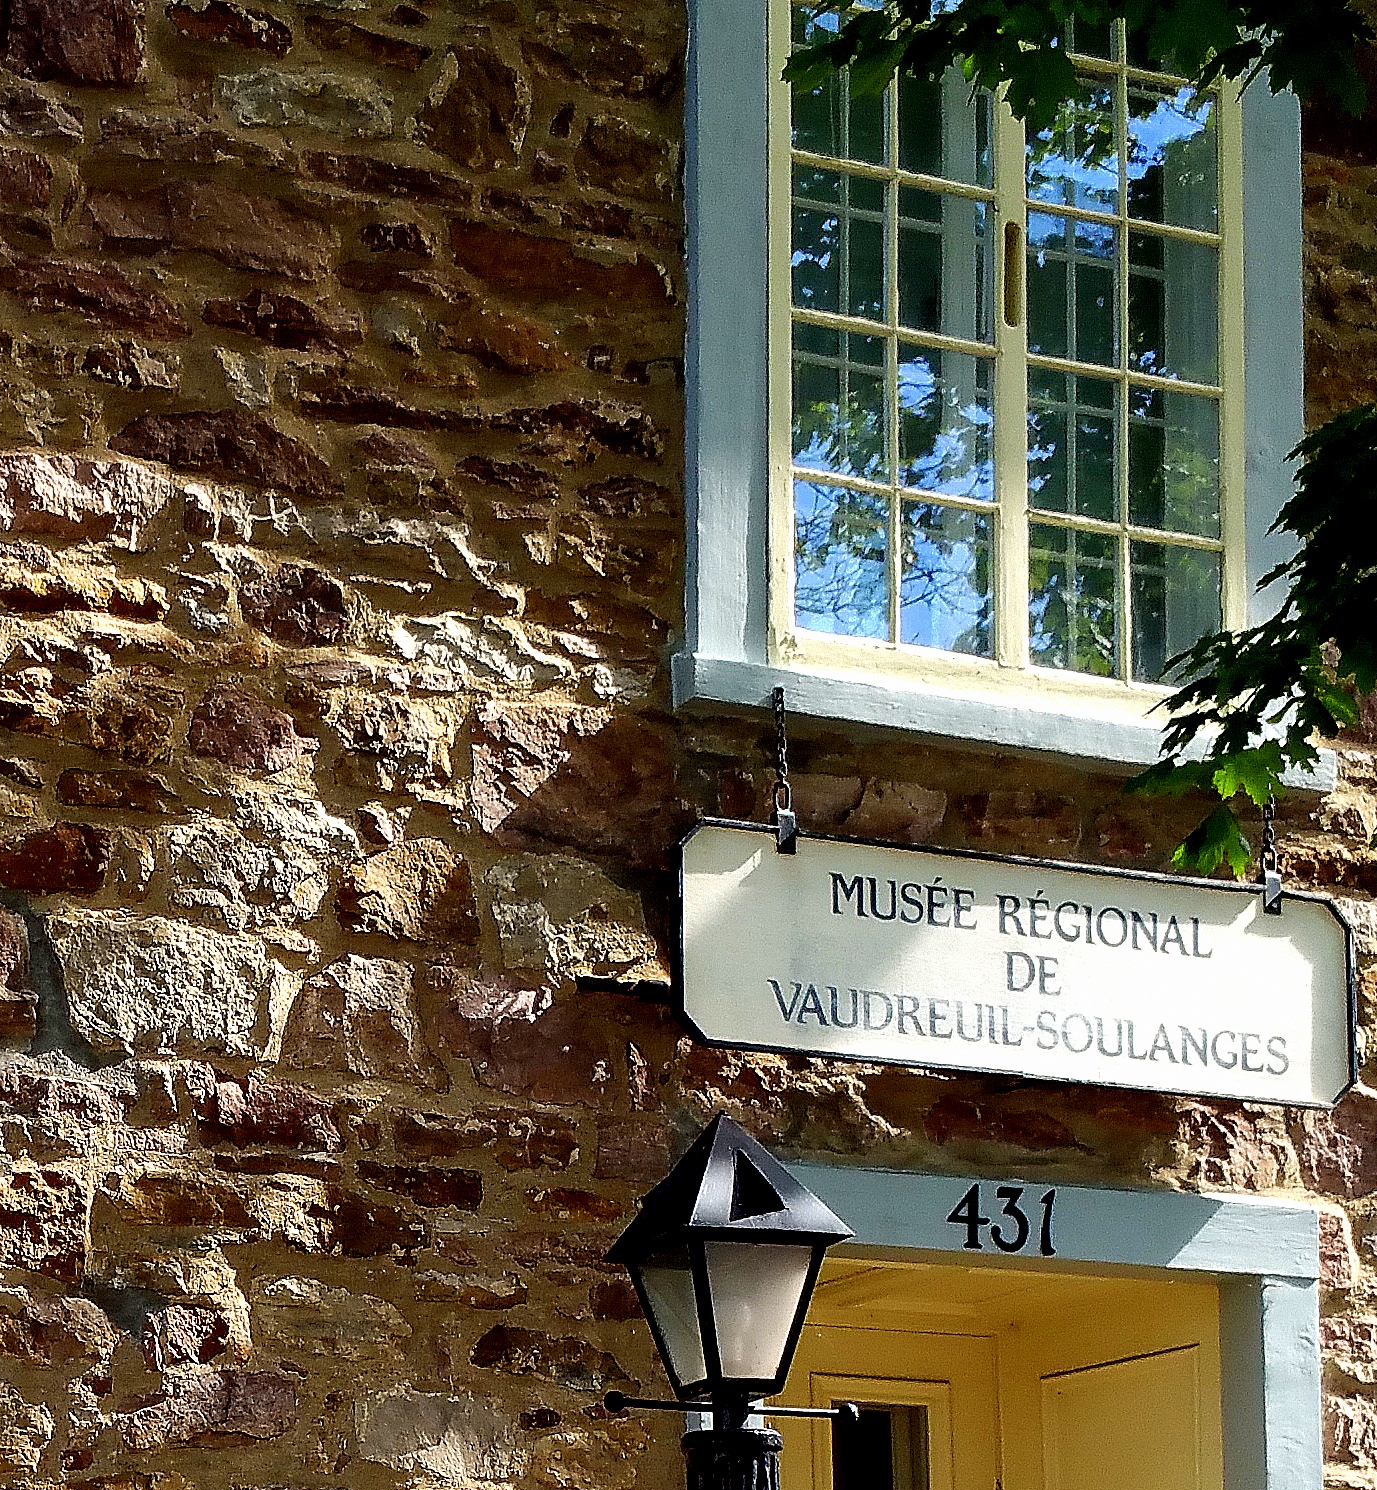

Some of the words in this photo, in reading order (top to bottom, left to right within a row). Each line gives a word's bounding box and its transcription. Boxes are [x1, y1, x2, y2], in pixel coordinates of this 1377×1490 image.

[828, 871, 978, 930] MUSÉE
[995, 888, 1214, 959] RÉGIONAL
[1003, 950, 1062, 997] DE
[766, 978, 1291, 1076] VAUDREUIL-SOULANGES
[945, 1182, 1057, 1257] 431
